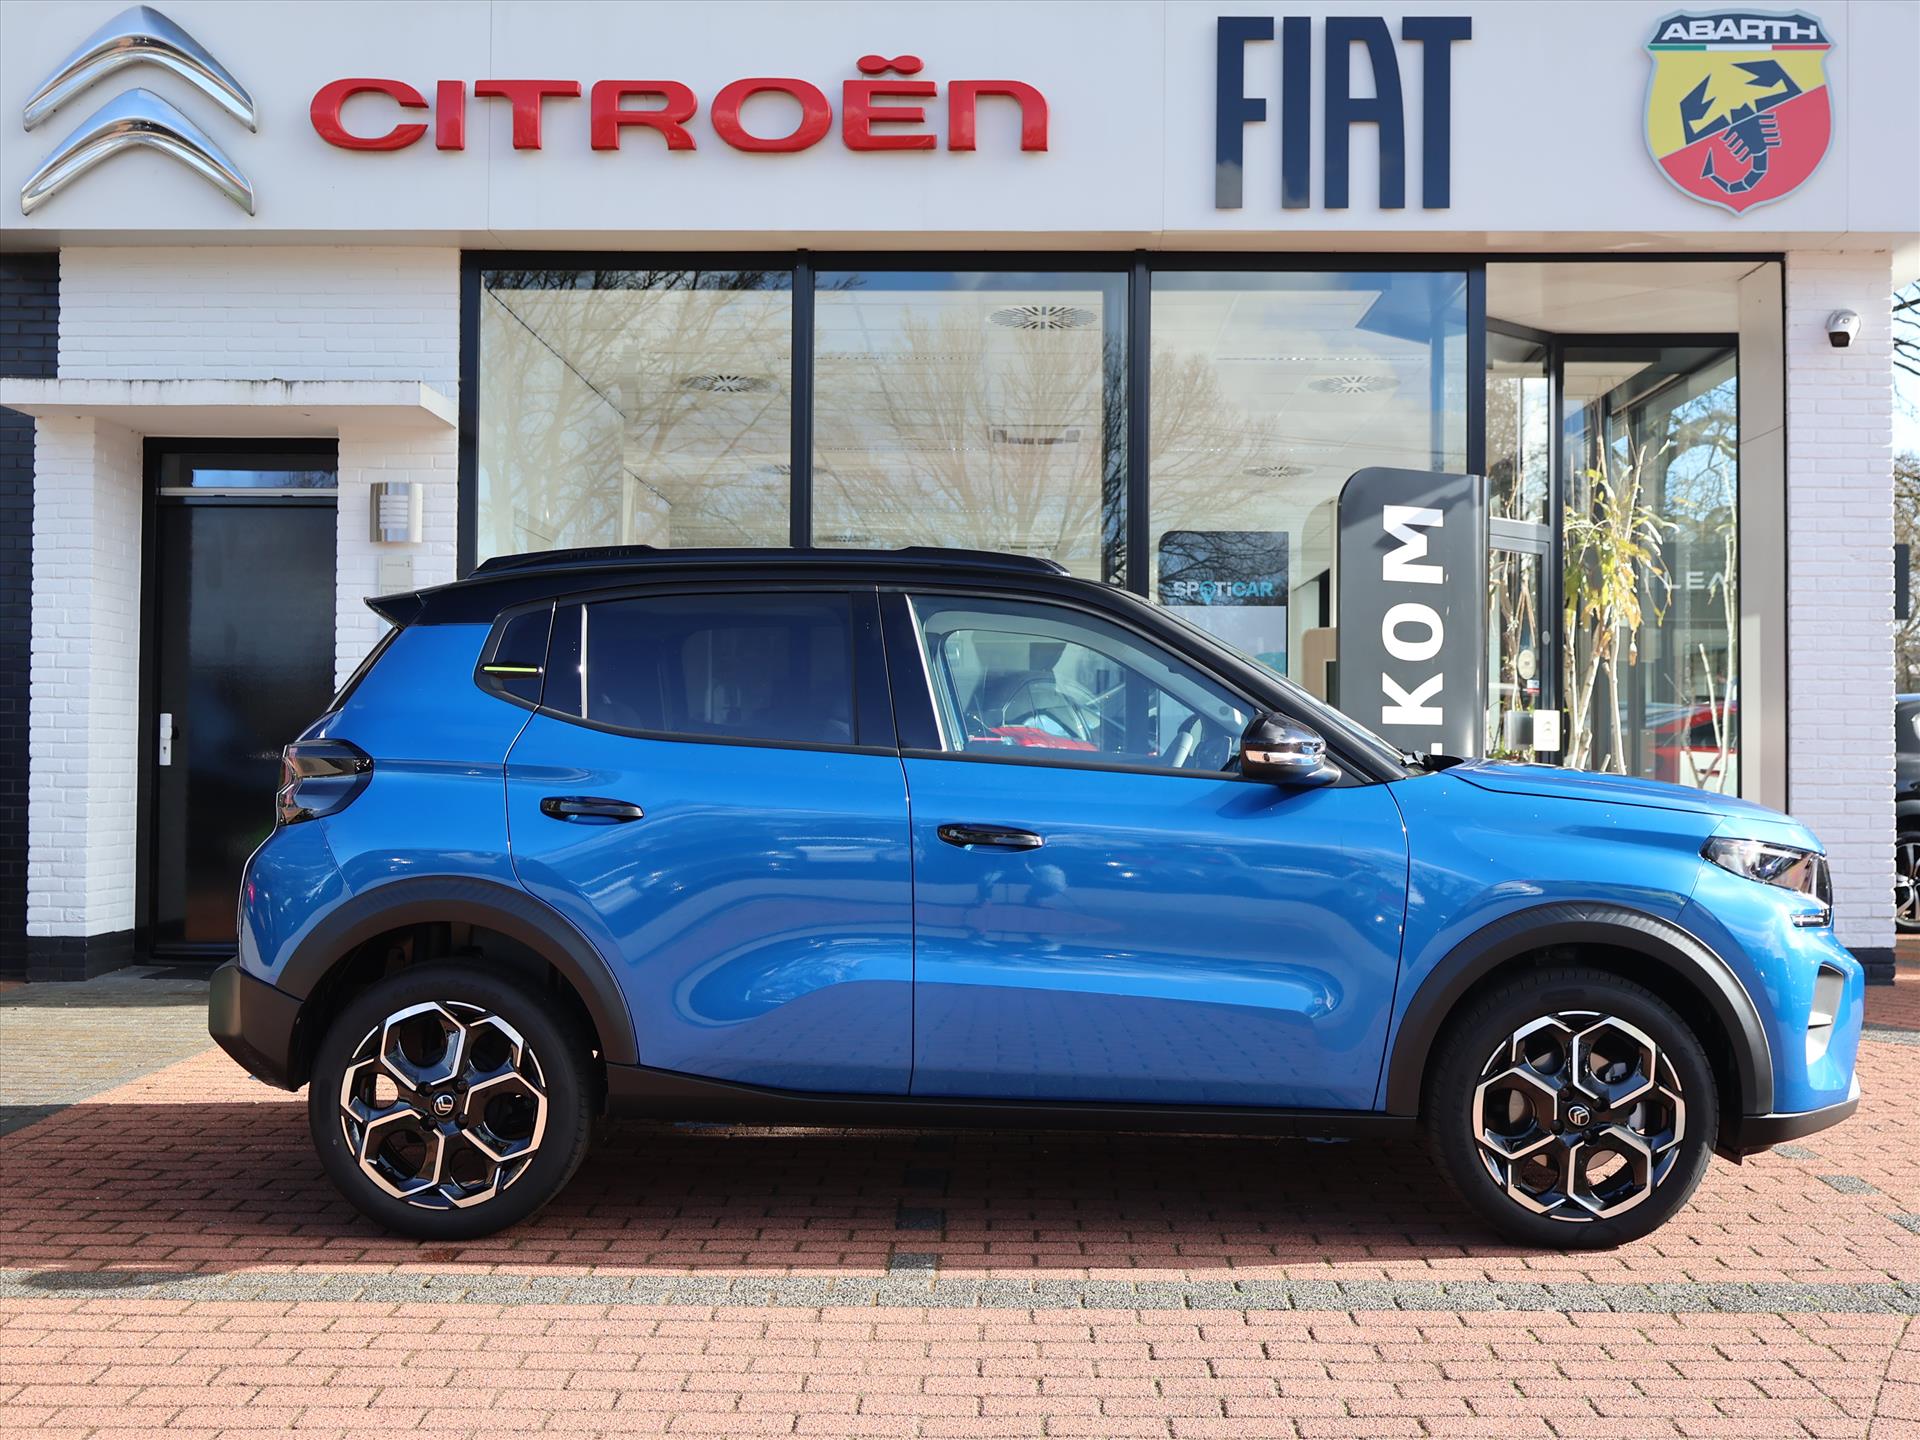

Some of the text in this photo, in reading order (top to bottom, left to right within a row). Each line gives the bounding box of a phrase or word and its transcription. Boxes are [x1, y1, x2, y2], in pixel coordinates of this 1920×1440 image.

[1215, 16, 1472, 209] FIAT
[1660, 19, 1818, 40] ABARTH
[1382, 504, 1444, 755] KOM
